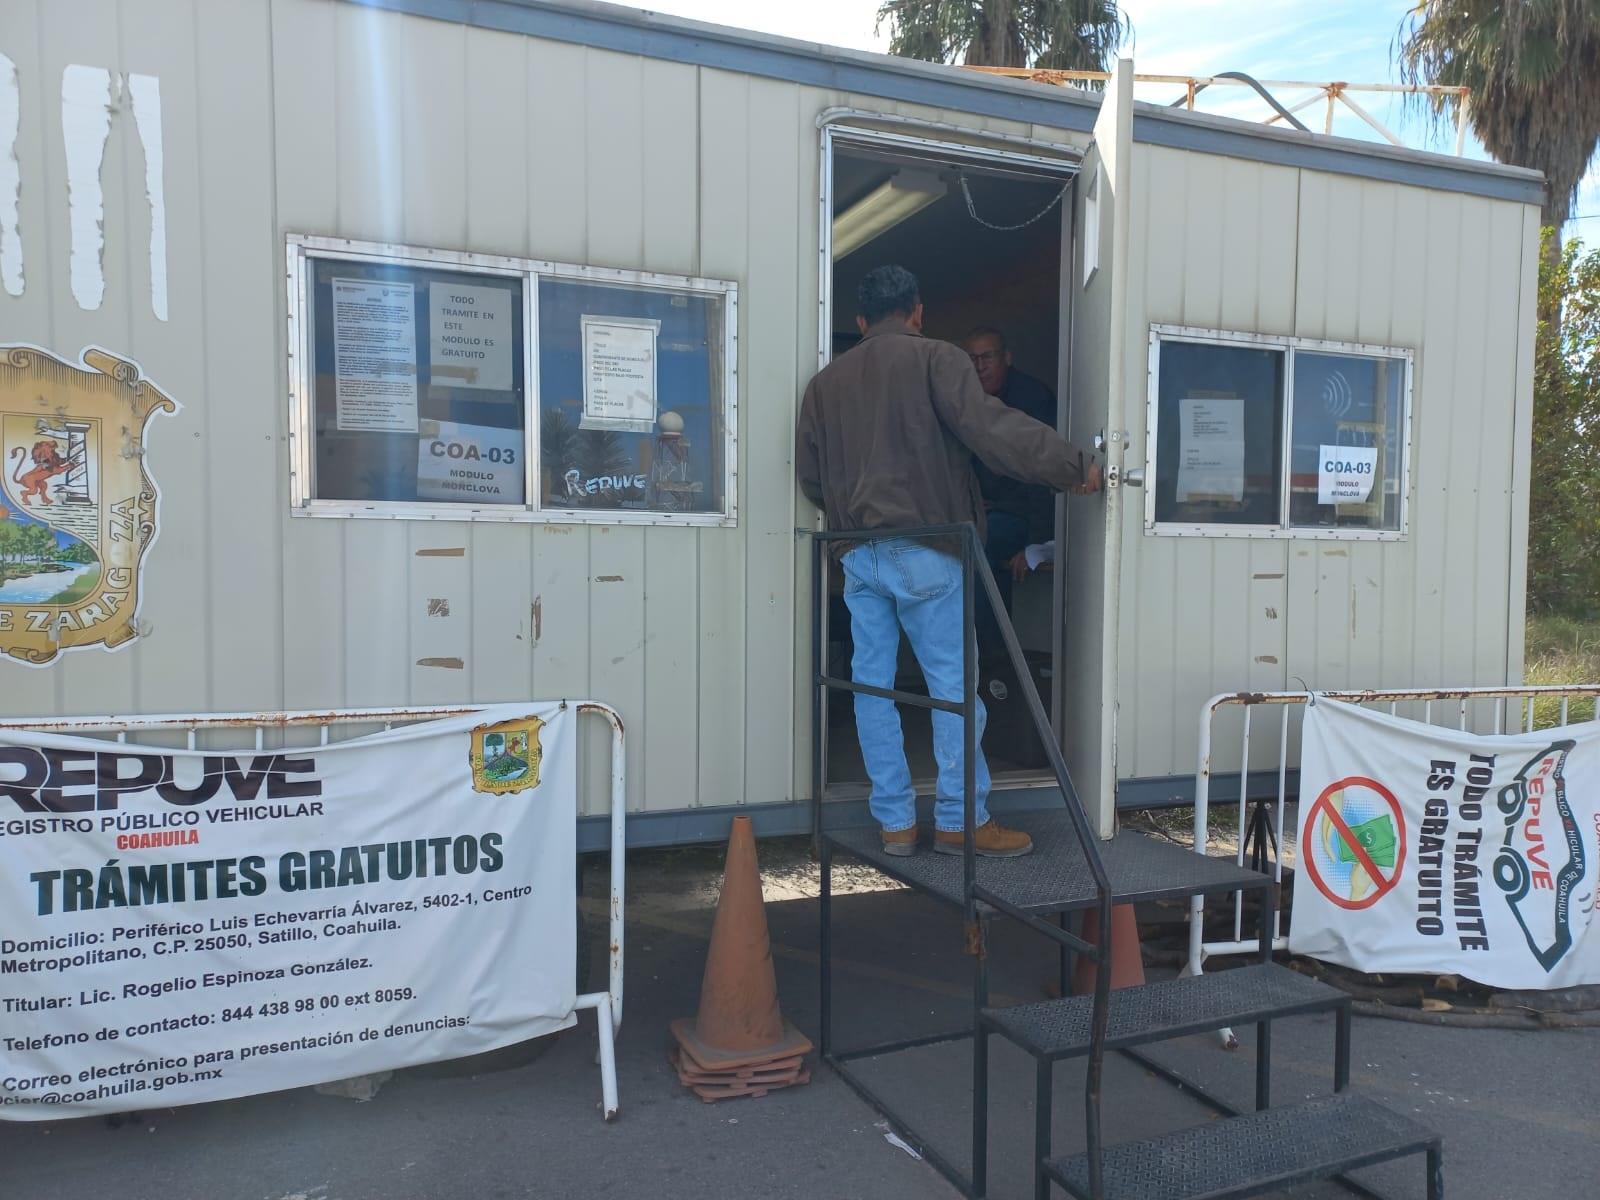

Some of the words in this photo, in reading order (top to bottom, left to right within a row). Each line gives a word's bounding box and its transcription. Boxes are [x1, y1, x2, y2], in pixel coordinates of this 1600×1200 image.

[442, 308, 478, 319] TRAMITE
[483, 311, 494, 320] EN
[450, 296, 474, 305] TODO
[442, 335, 480, 345] MODULO
[484, 338, 494, 346] ES
[444, 322, 462, 330] ESTE
[442, 349, 485, 358] GRATUITO
[430, 441, 515, 464] COA-03
[450, 469, 494, 480] MODULO
[1325, 461, 1371, 474] COA-03
[25, 496, 136, 632] ZARAGZA
[0, 746, 322, 813] REPUVE
[1427, 760, 1456, 791] ES
[1459, 754, 1496, 821] TODO
[101, 811, 200, 832] PÚBLICO
[206, 802, 324, 824] VEHICULAR
[116, 830, 199, 849] COAHUILA
[1524, 758, 1555, 890] REPUVE
[31, 859, 267, 916] TRÁMITES
[278, 832, 503, 892] GRATUITOS
[1416, 798, 1448, 936] GRATUITO
[1454, 827, 1490, 951] TRÁMITE
[2, 932, 104, 954] Domicilio:
[113, 922, 203, 942] Periférico
[210, 915, 248, 931] Luis
[254, 904, 347, 927] Echevarría
[352, 900, 417, 916] Álvarez,
[423, 893, 478, 908] 5402-1,
[483, 885, 532, 902] Centro
[1559, 879, 1573, 923] COAHUILA
[1, 946, 146, 974] Metropolitano,
[154, 939, 188, 955] C.P.
[195, 934, 252, 952] 25050,
[258, 925, 318, 944] Satillo,
[323, 918, 401, 937] Coahuila.
[3, 994, 72, 1012] Titular:
[80, 988, 116, 1005] Lic.
[123, 977, 196, 998] Rogelio
[203, 969, 285, 987] Espinoza
[291, 958, 372, 976] González.
[3, 1032, 90, 1051] Telefono
[96, 1028, 119, 1041] de
[127, 1013, 215, 1037] contacto:
[222, 1007, 253, 1022] 844
[259, 1002, 290, 1016] 438
[295, 997, 314, 1012] 98
[320, 996, 339, 1009] 00
[345, 992, 370, 1005] ext
[375, 988, 417, 1002] 8059.
[3, 1073, 71, 1092] Correo
[79, 1057, 187, 1082] electrónico
[194, 1050, 234, 1067] para
[240, 1031, 353, 1060] presentación
[359, 1028, 378, 1042] de
[384, 1015, 470, 1038] denuncias:
